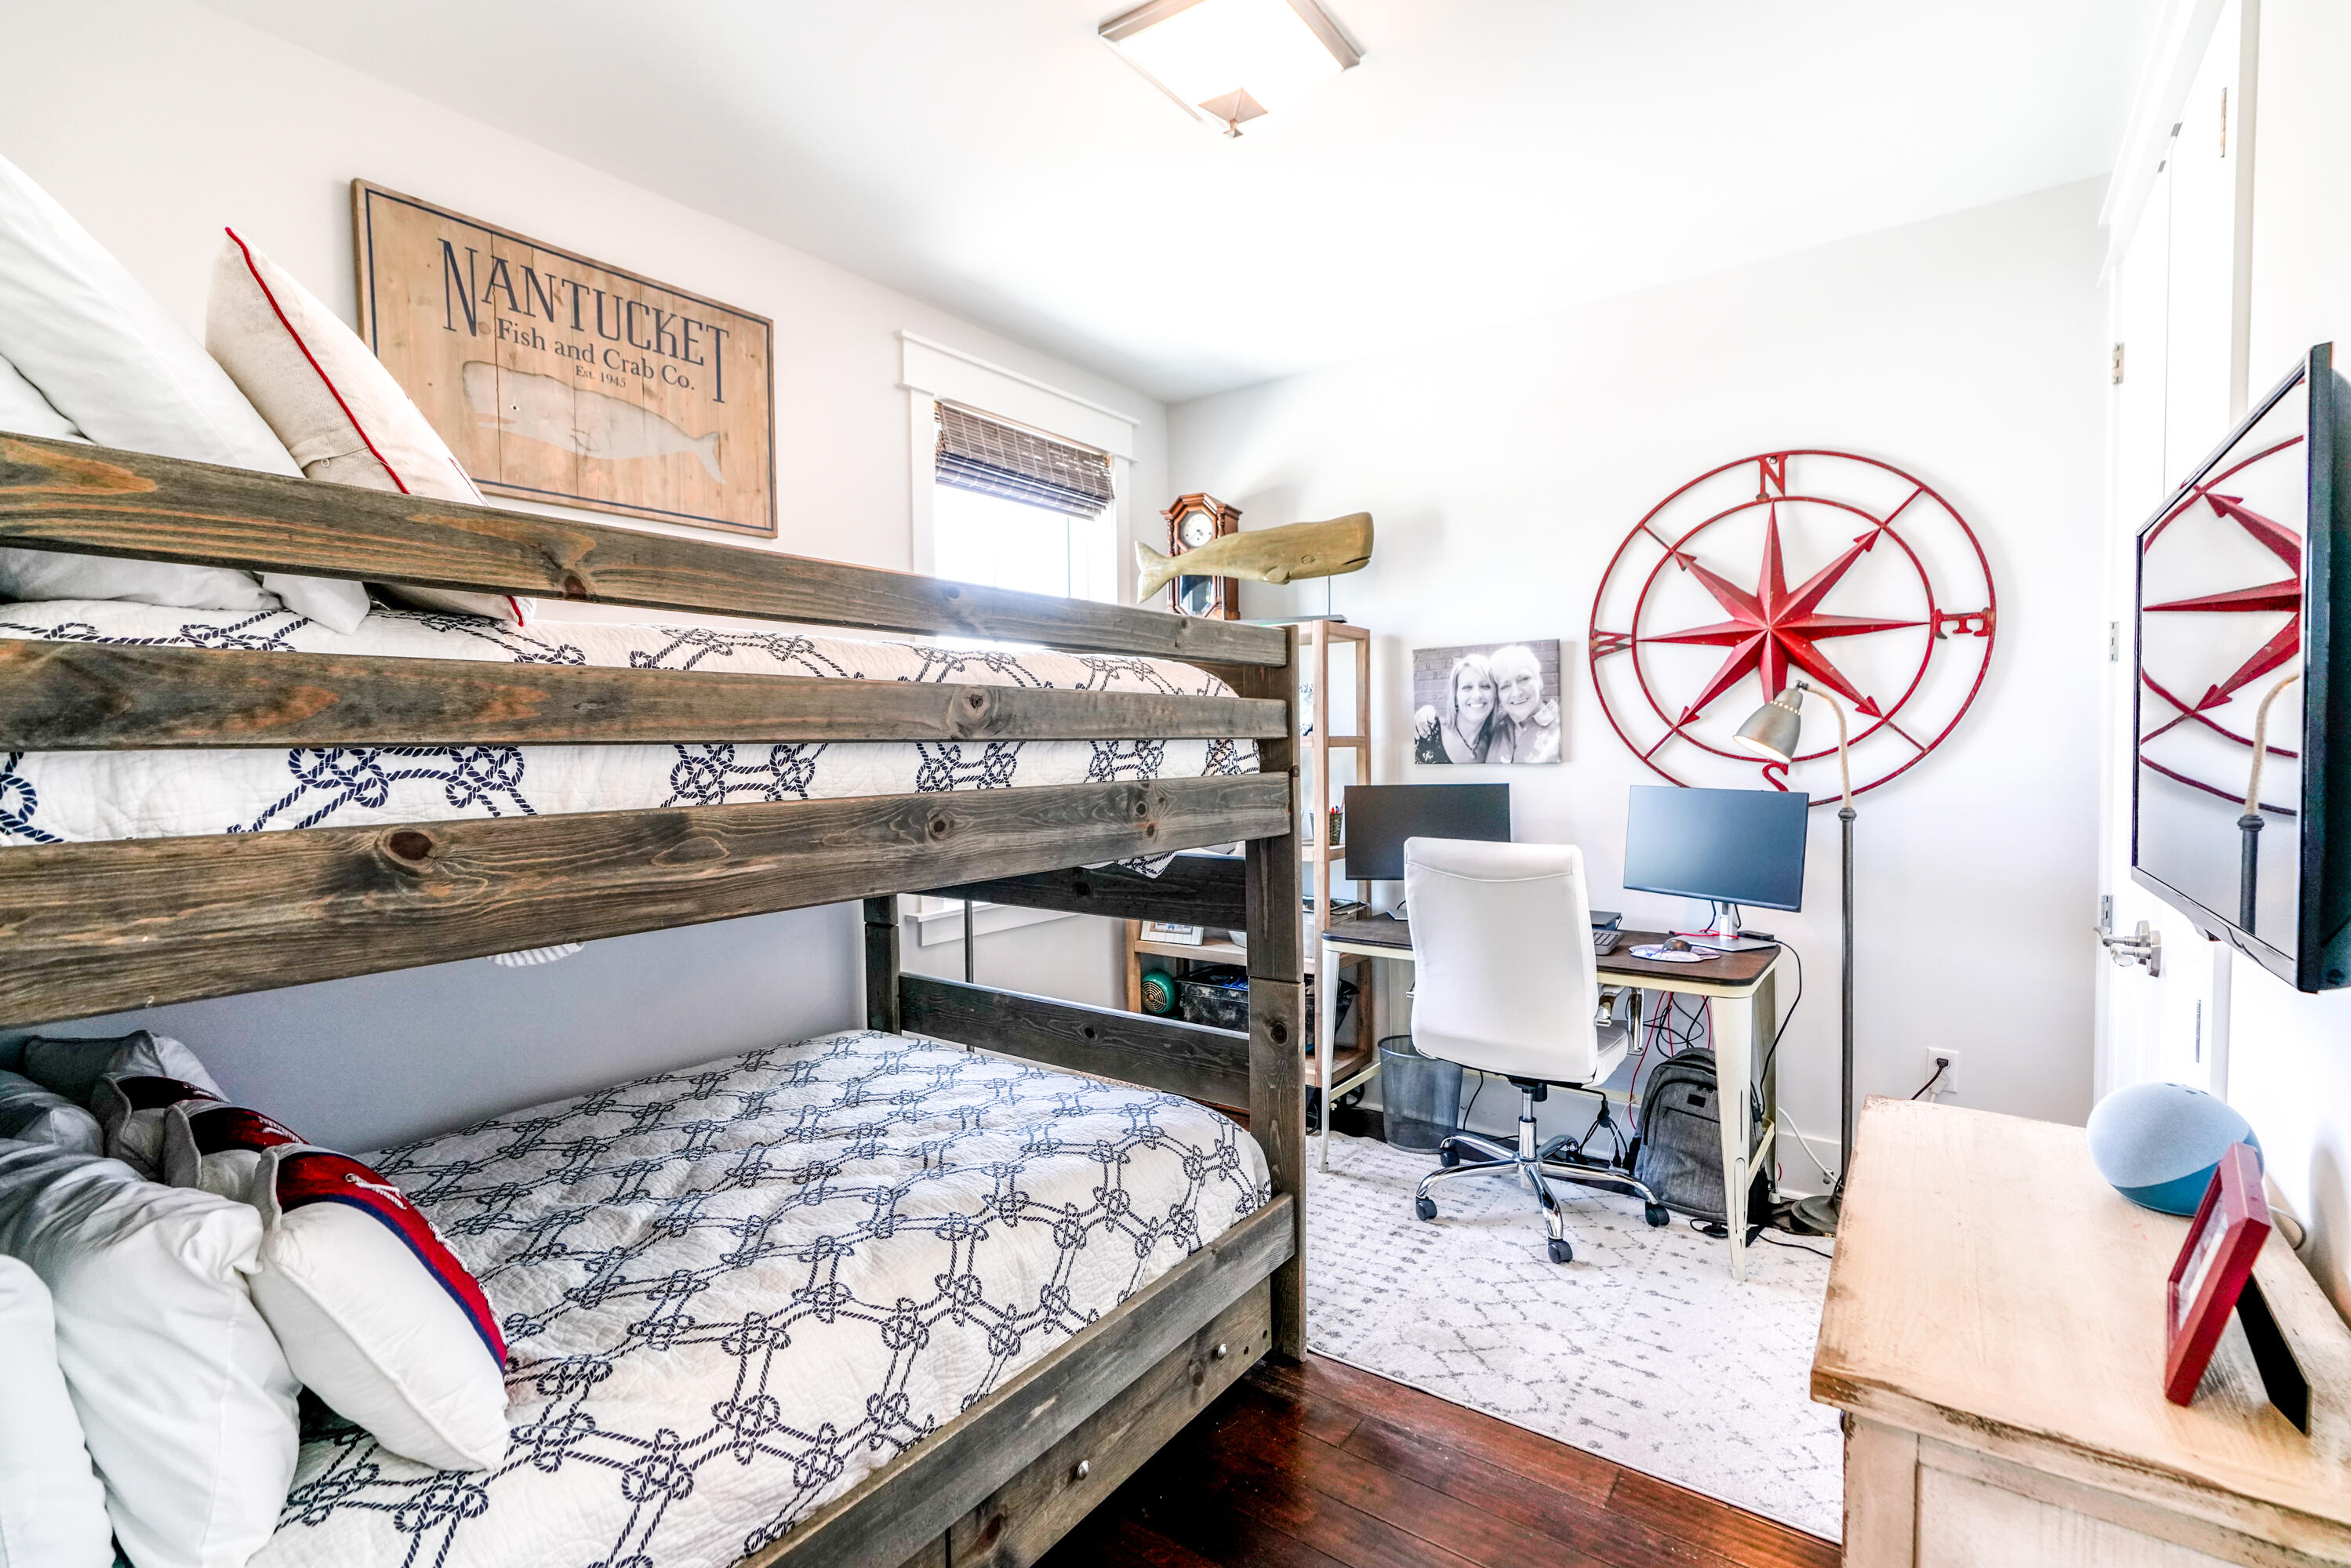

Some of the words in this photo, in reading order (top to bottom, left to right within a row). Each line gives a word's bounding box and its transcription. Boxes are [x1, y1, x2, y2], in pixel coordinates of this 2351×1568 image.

[438, 238, 729, 403] NANTUCKET
[496, 318, 546, 351] Fish
[554, 339, 595, 364] and
[603, 348, 654, 379] Crab
[661, 365, 695, 390] Co.
[576, 365, 595, 379] Est.
[601, 372, 626, 387] 1945
[1756, 454, 1789, 503] N
[1935, 607, 1994, 640] E
